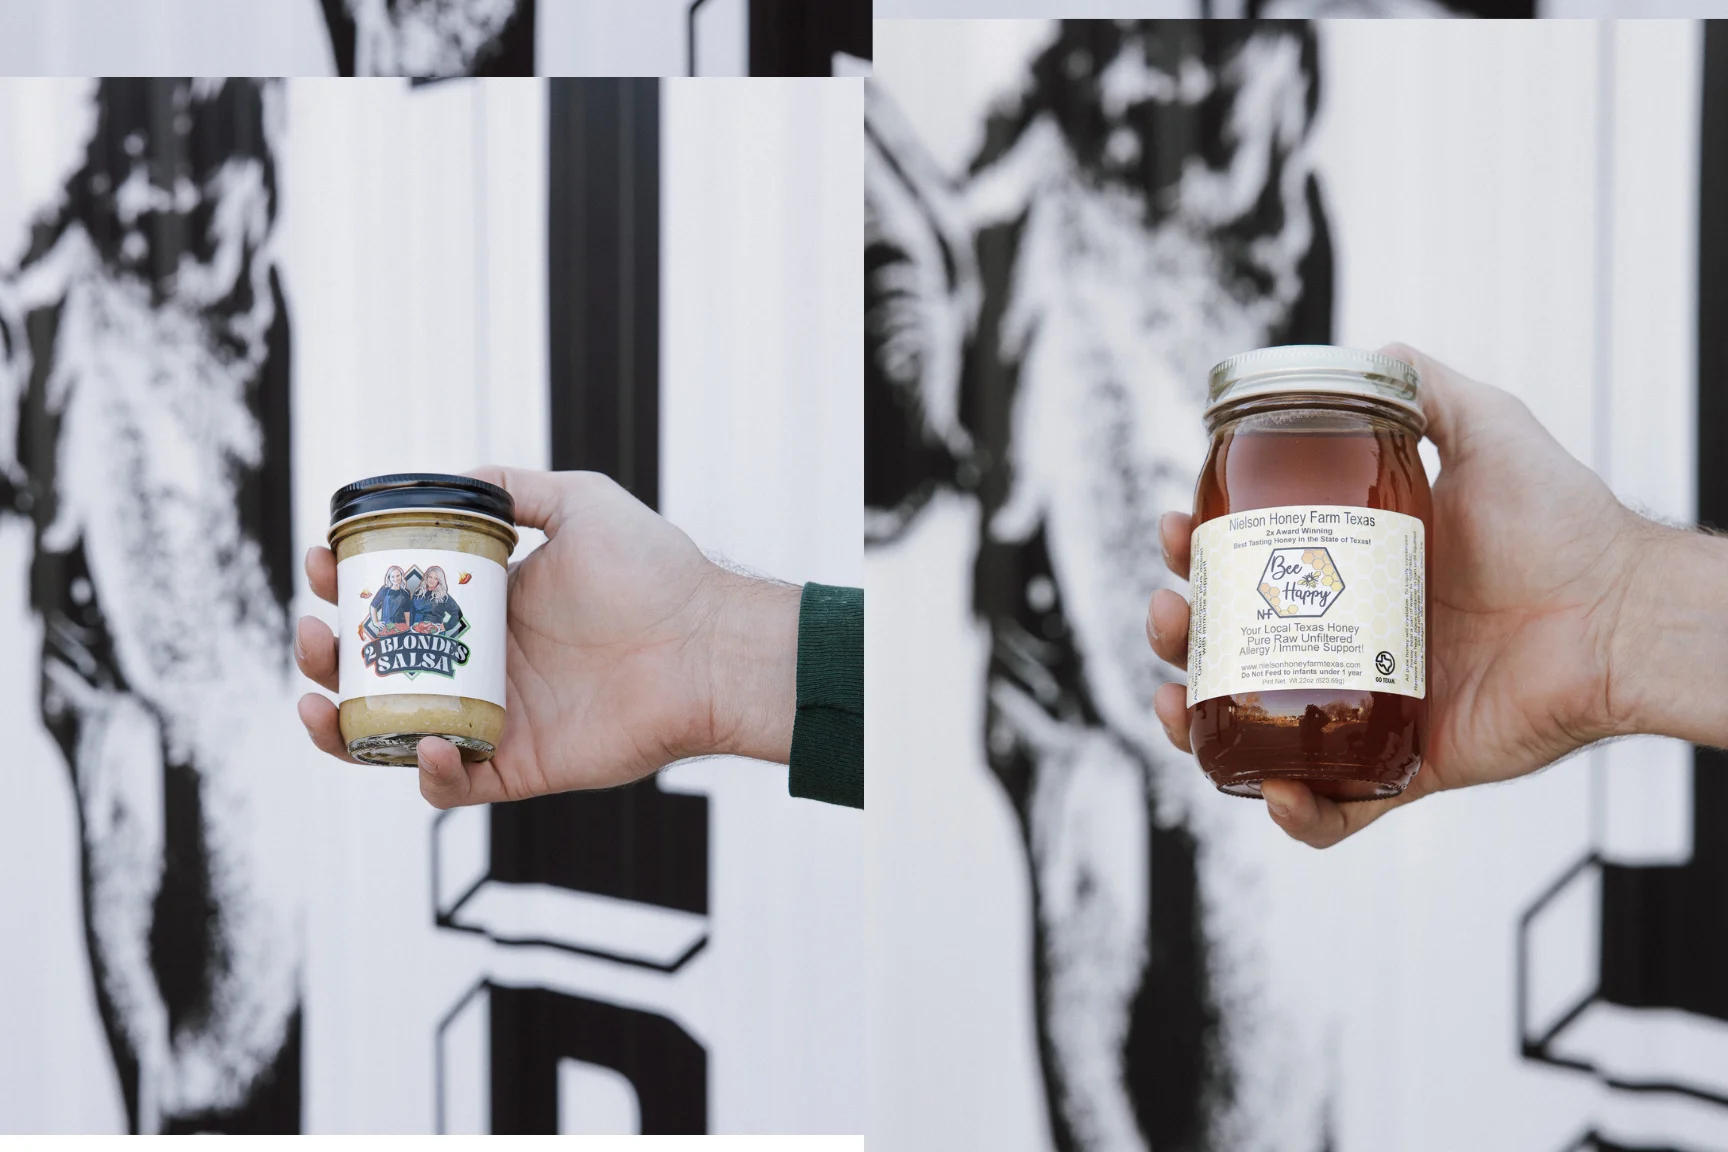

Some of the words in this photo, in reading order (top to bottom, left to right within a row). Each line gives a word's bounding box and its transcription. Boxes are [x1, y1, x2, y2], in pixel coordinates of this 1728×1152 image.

[1229, 516, 1266, 532] Nielson
[1269, 512, 1306, 526] Honey
[1310, 510, 1341, 524] Farm
[1344, 511, 1376, 527] Texas
[1266, 529, 1275, 537] 2x
[1276, 528, 1300, 536] Award
[1301, 527, 1333, 536] Winning
[1248, 539, 1272, 547] Tasting
[1273, 537, 1296, 545] Honey
[1320, 535, 1339, 543] State
[1350, 537, 1371, 545] Texas!
[1271, 555, 1303, 580] Bee
[1282, 581, 1331, 607] Happy
[1240, 626, 1261, 636] Your
[1264, 623, 1291, 634] Local
[1294, 623, 1324, 633] Texas
[1327, 623, 1359, 635] Honey
[1247, 636, 1270, 646] Pure
[1274, 634, 1298, 644] Raw
[1301, 633, 1352, 644] Unfiltered
[365, 645, 377, 659] 2
[380, 635, 468, 661] BLONDES
[1239, 645, 1270, 656] Allergy
[1272, 644, 1276, 652] /
[1279, 643, 1319, 652] Immune
[1323, 643, 1364, 654] Support!
[378, 652, 450, 672] SALSA
[1241, 660, 1361, 671] www.nielsonhoneyfarmtexas.com
[1252, 670, 1263, 678] Not
